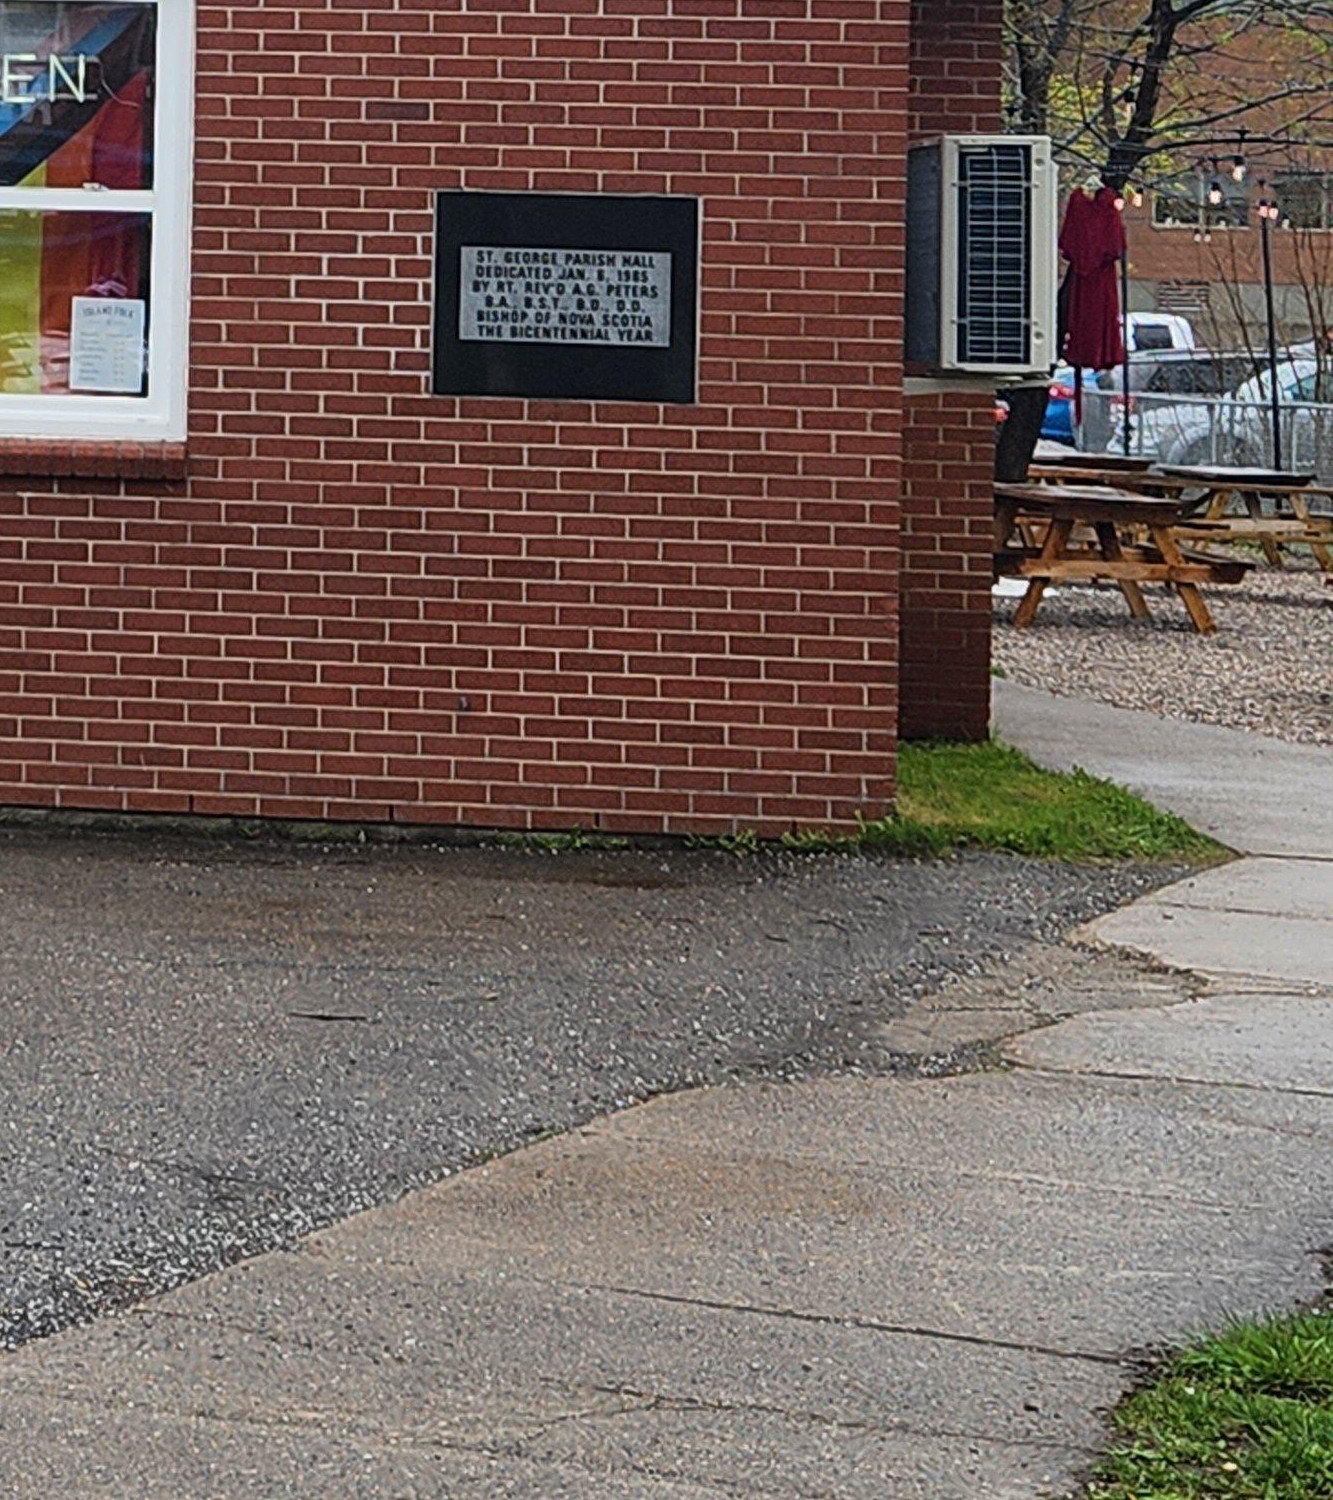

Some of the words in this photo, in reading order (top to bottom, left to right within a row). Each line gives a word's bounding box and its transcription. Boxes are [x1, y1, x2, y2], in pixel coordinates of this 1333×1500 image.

[477, 250, 498, 264] ST.
[504, 251, 558, 265] GEORGE
[565, 253, 616, 267] PARISH
[621, 255, 655, 269] HALL
[476, 265, 552, 280] DEDICATED
[473, 280, 490, 293] BY
[606, 284, 659, 299] PETERS
[477, 310, 529, 323] BISHOP
[535, 311, 551, 324] OF
[558, 312, 595, 326] NOVA
[602, 314, 653, 328] SCOTIA
[477, 325, 503, 338] THE
[510, 326, 611, 340] BICENTENNIAL
[617, 328, 653, 342] YEAR
